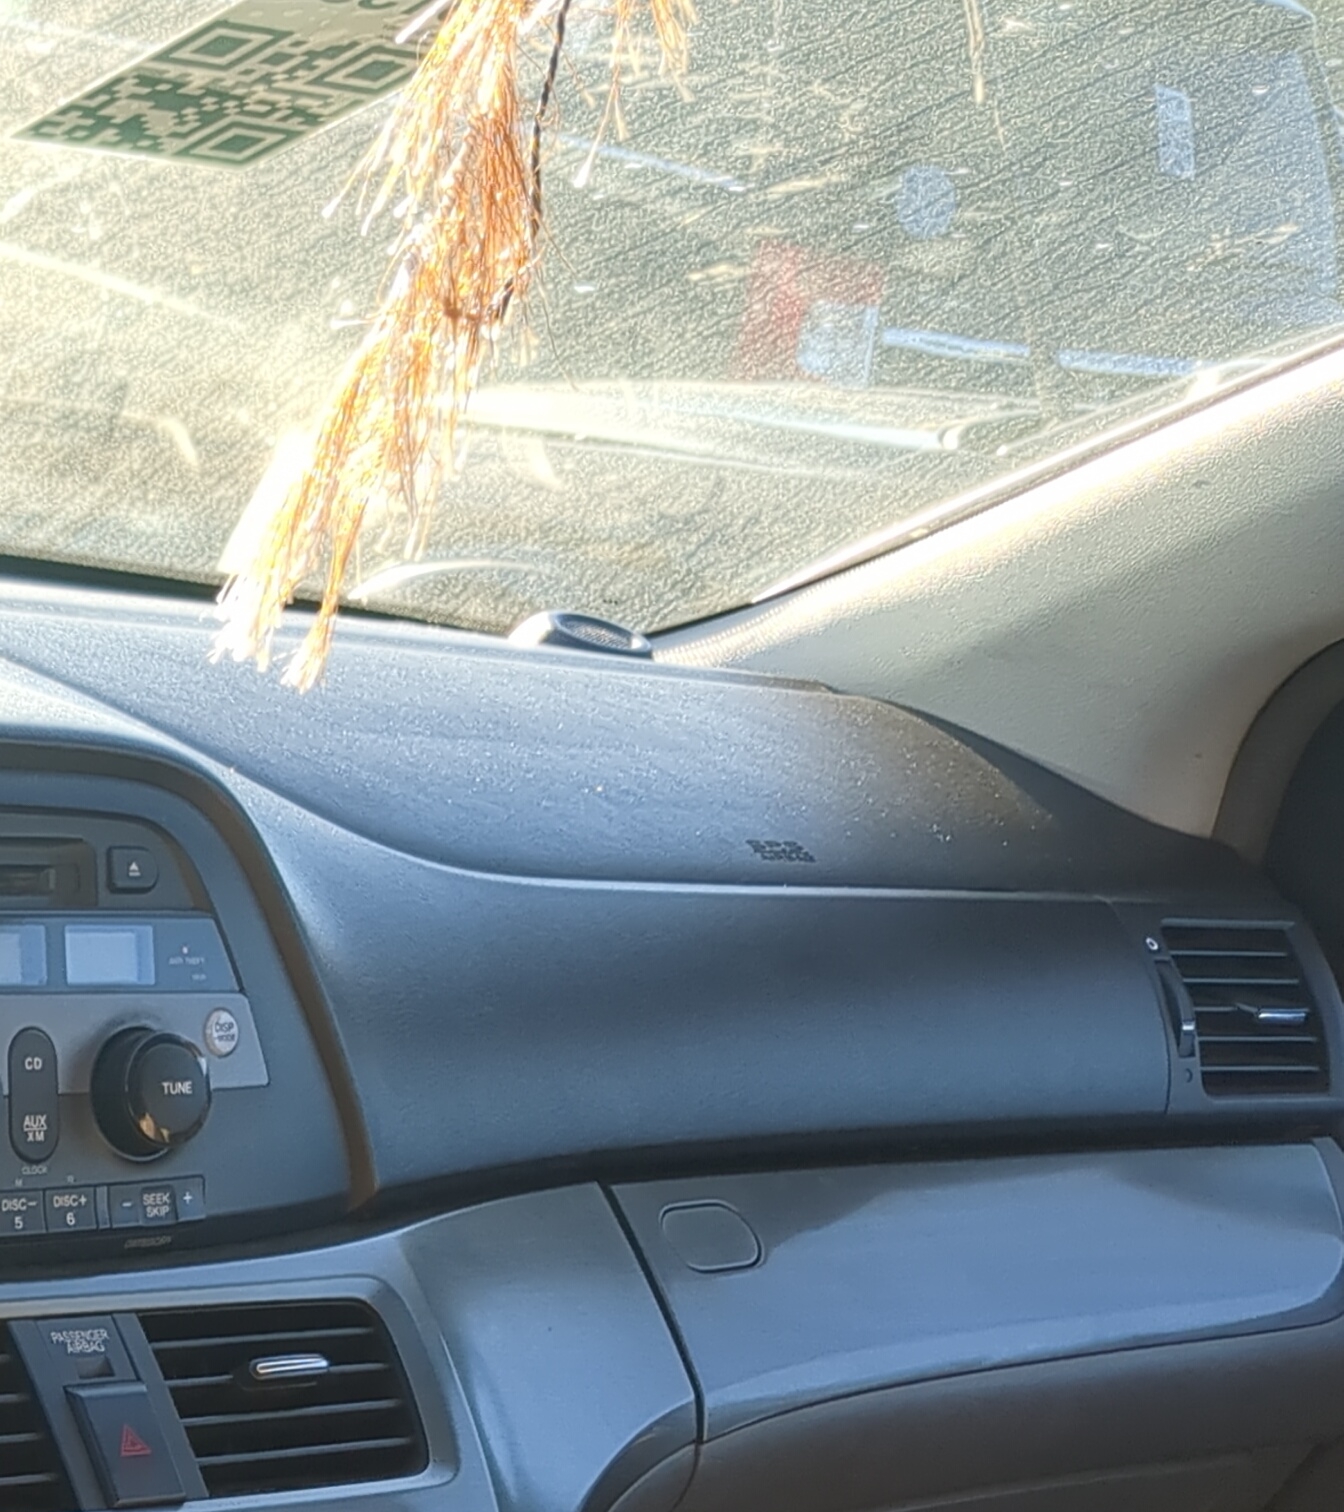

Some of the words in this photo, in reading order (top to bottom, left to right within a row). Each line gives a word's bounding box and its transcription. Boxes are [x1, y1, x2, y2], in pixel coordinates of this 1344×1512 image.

[24, 1057, 42, 1070] CD
[162, 1081, 193, 1095] TUNE
[23, 1114, 47, 1128] AUX
[27, 1130, 45, 1142] XM
[143, 1193, 170, 1206] SEEK
[146, 1205, 170, 1218] SKIP
[14, 1216, 24, 1229] 5
[66, 1212, 76, 1226] 6
[50, 1328, 110, 1344] PASSENGER
[67, 1340, 105, 1354] AIRBAG
